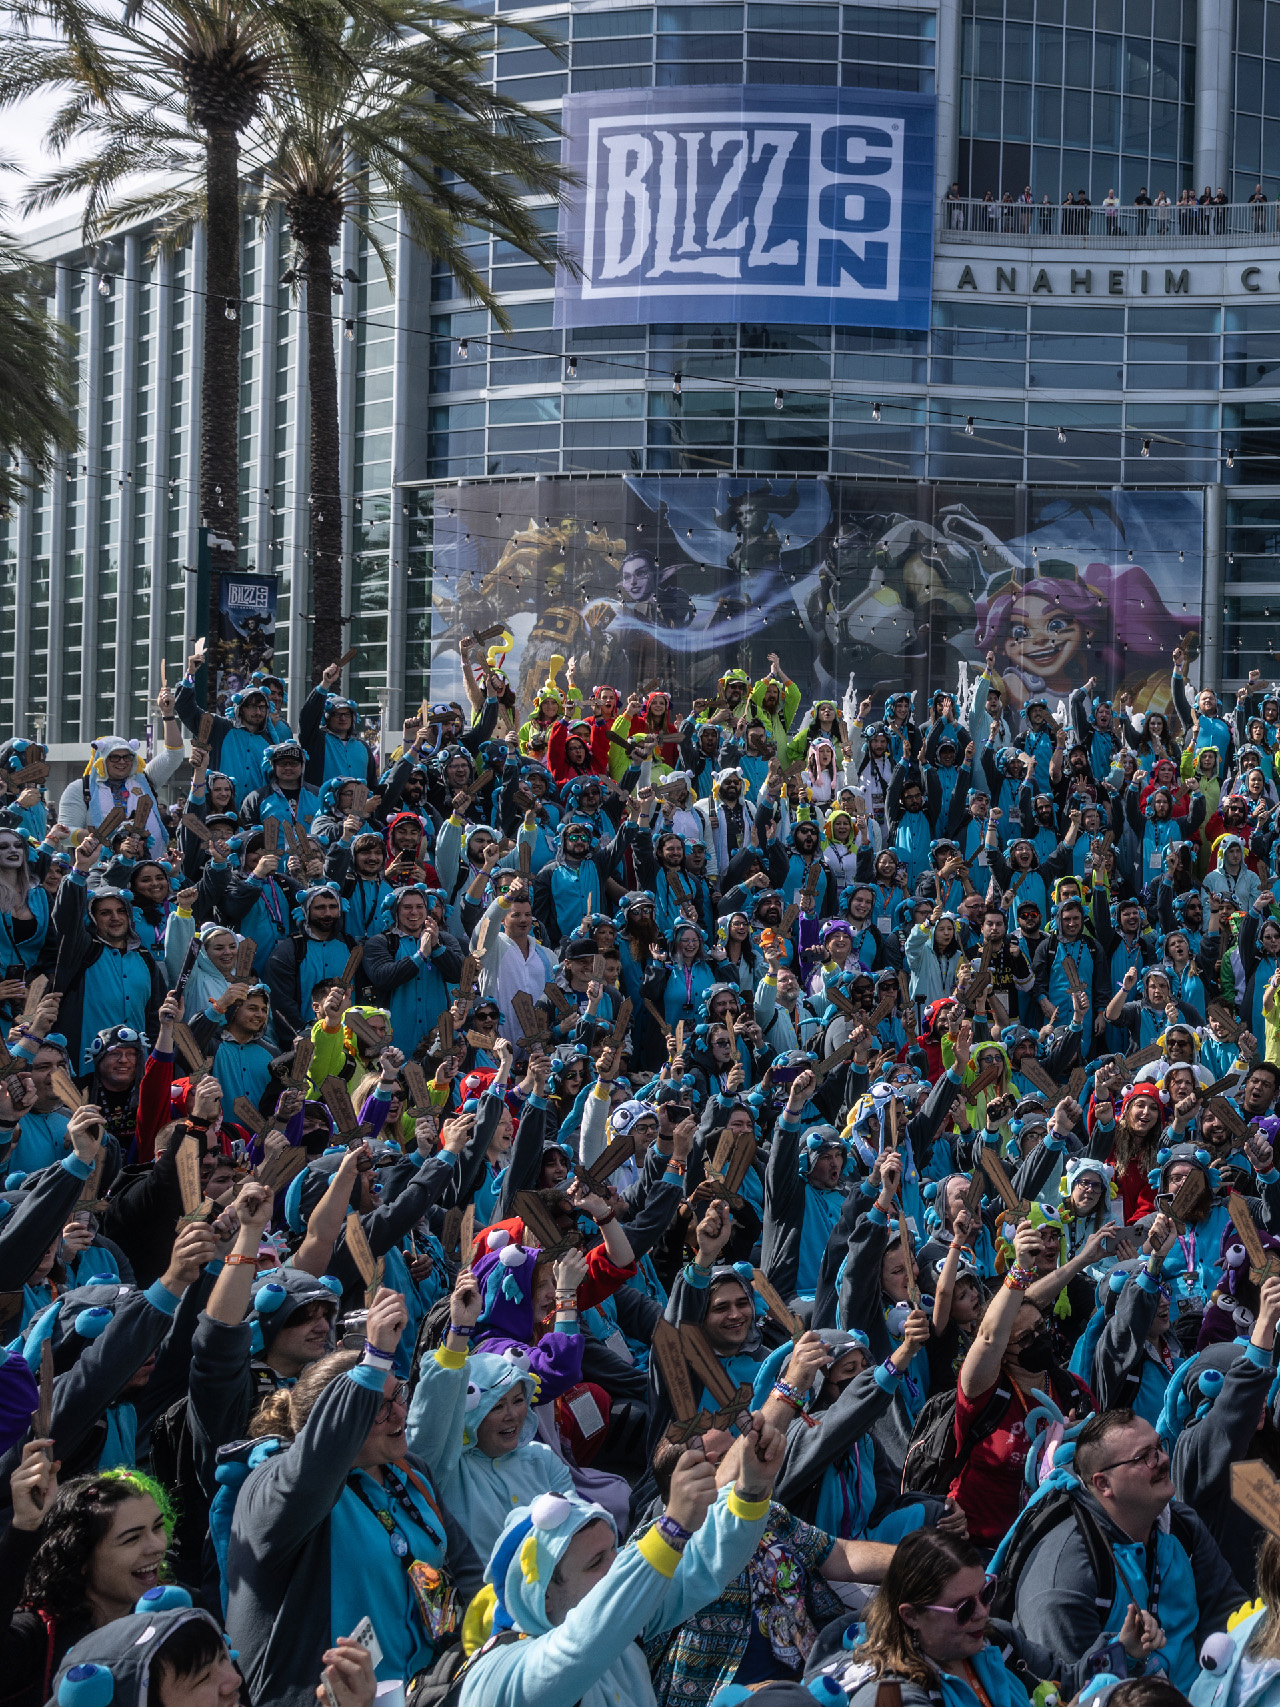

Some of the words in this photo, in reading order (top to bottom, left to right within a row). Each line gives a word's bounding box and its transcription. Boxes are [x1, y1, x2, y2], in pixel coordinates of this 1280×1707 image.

[599, 130, 800, 279] BLIZZ
[816, 124, 894, 290] CON
[957, 264, 1190, 295] ANAHEIM
[231, 586, 256, 605] BLIZZ
